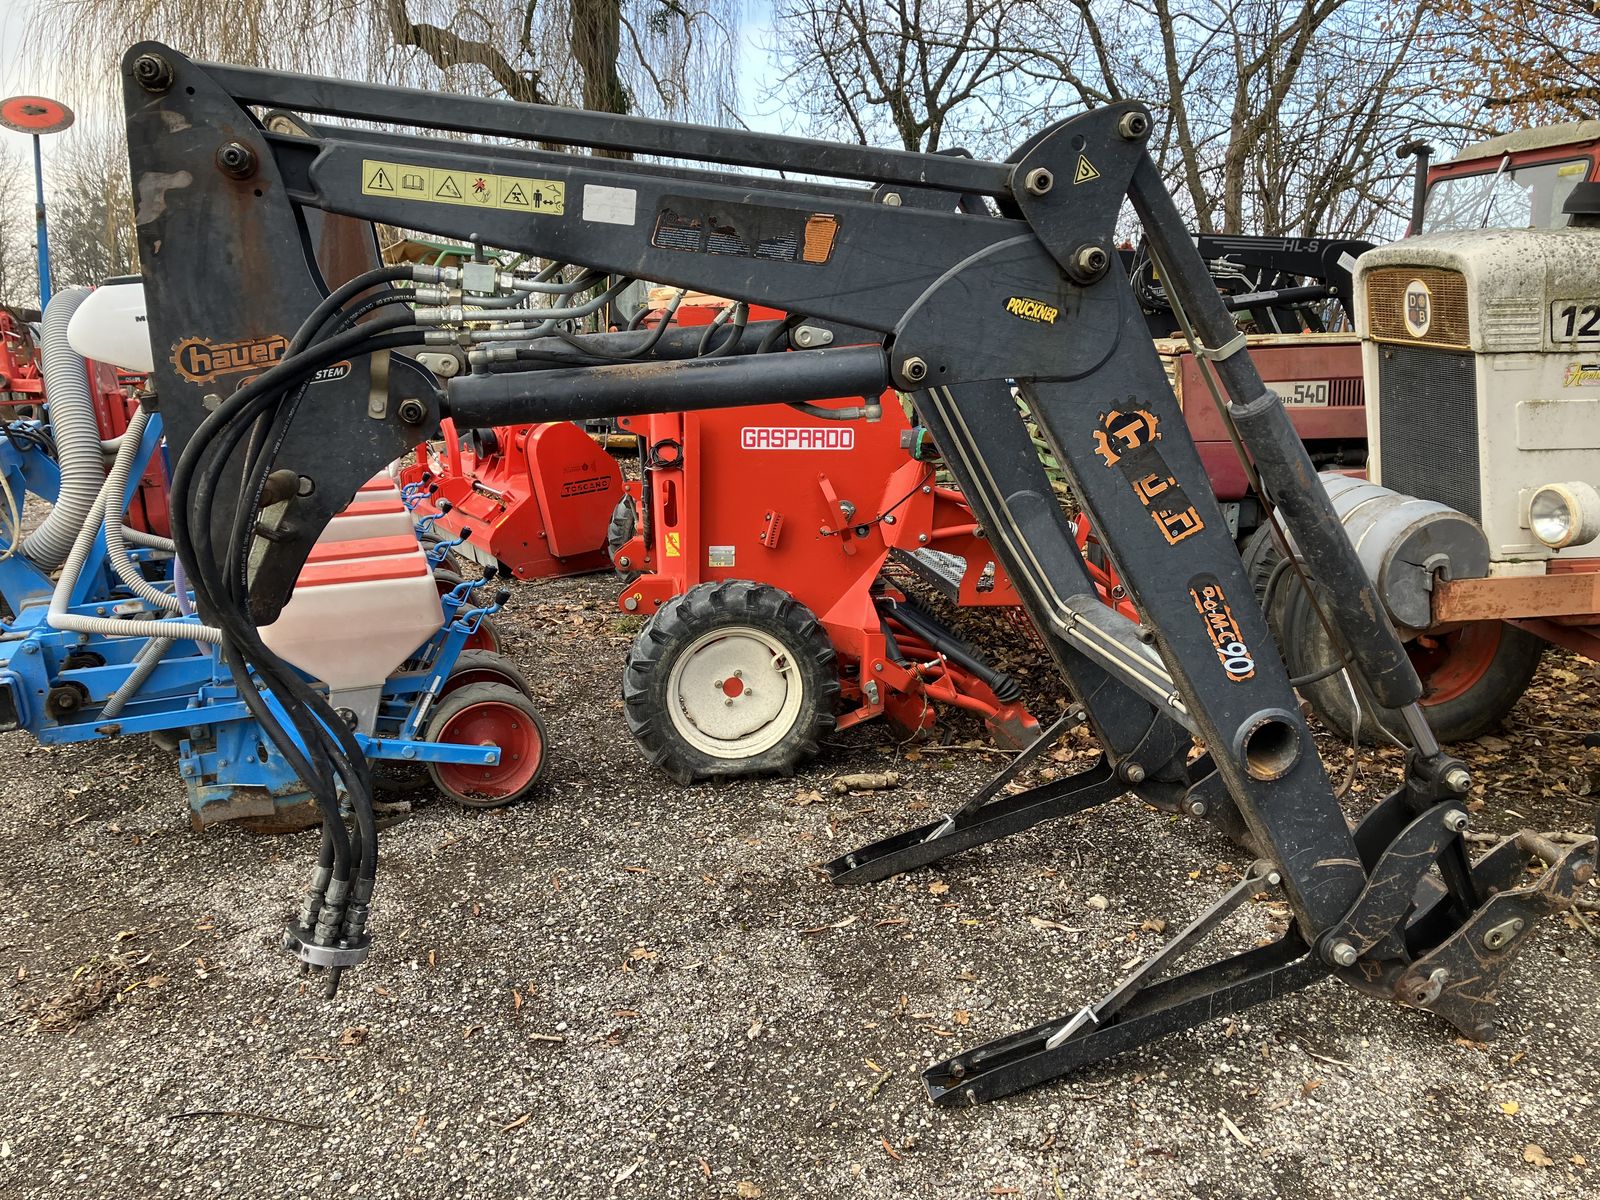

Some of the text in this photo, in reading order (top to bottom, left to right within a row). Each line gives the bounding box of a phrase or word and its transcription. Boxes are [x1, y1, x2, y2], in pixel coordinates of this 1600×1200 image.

[1282, 240, 1319, 253] HL-S
[1006, 297, 1058, 325] PRUCKNER
[189, 342, 285, 374] hauer
[312, 366, 344, 380] STEM
[1294, 384, 1327, 404] 540
[743, 429, 852, 448] GASPARDO
[564, 480, 608, 494] TOSCANO
